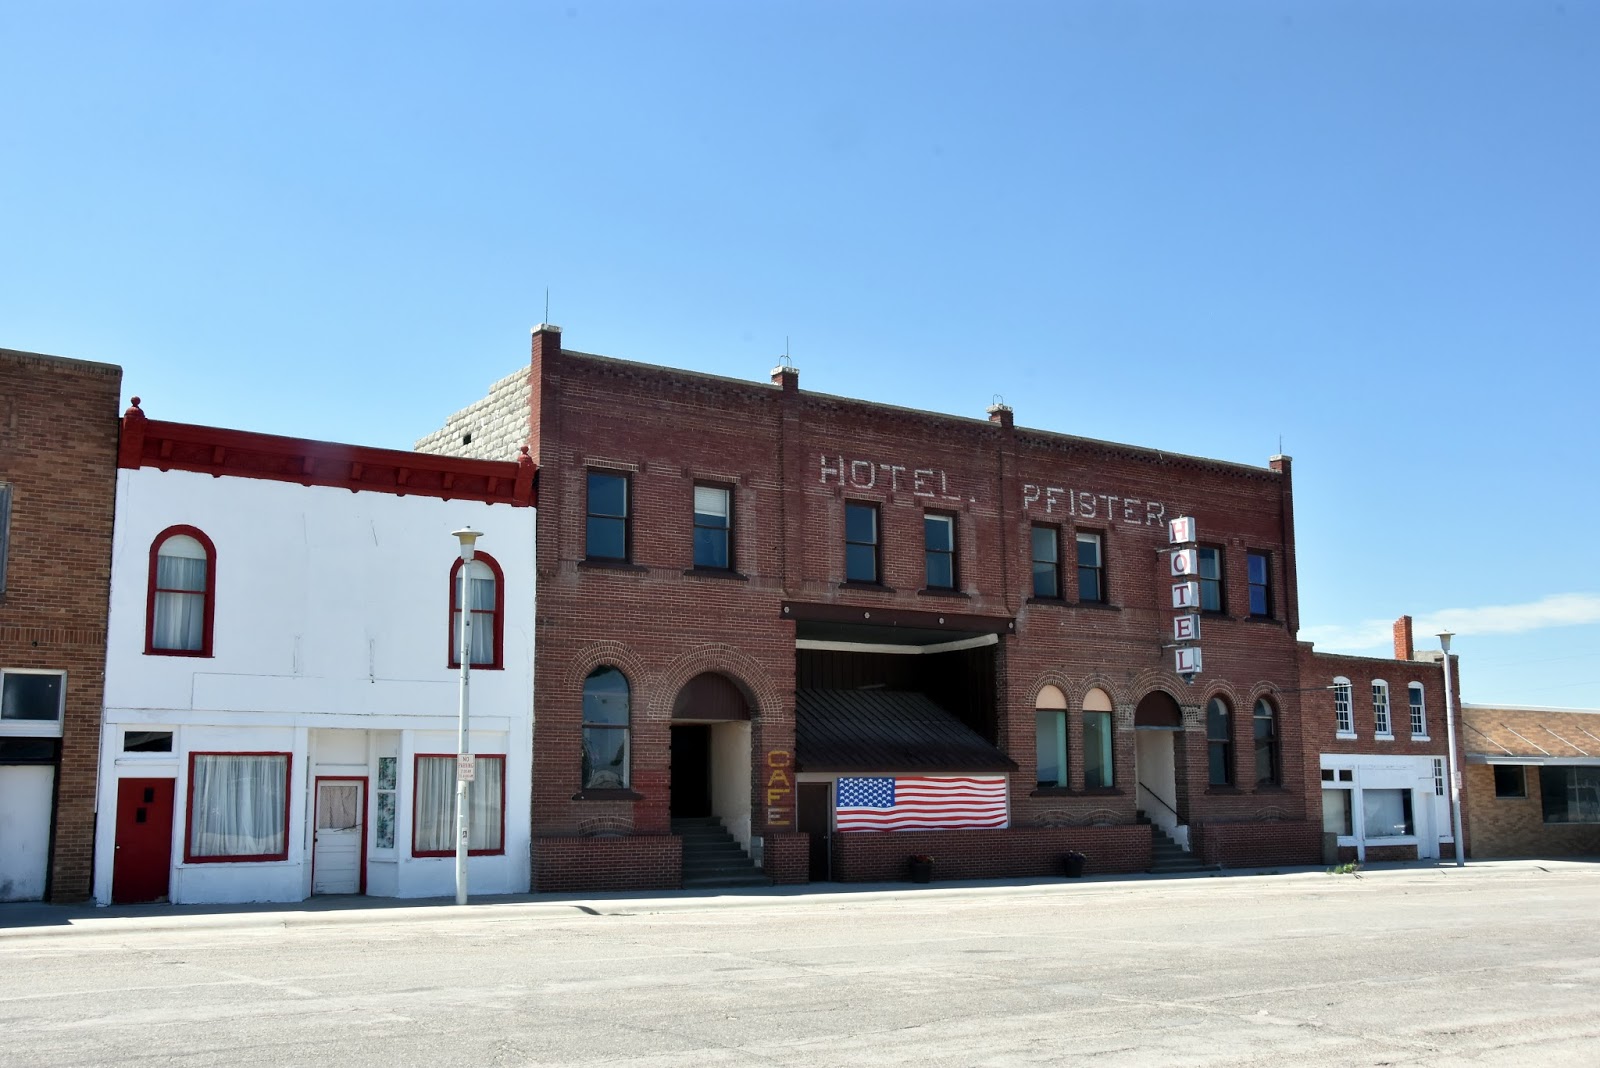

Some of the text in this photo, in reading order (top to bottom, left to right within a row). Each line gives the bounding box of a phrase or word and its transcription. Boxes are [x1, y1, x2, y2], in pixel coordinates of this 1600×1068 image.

[818, 453, 1166, 527] HOTEL PFISTER
[1170, 520, 1193, 671] HOTEL
[767, 750, 790, 826] CAFE
